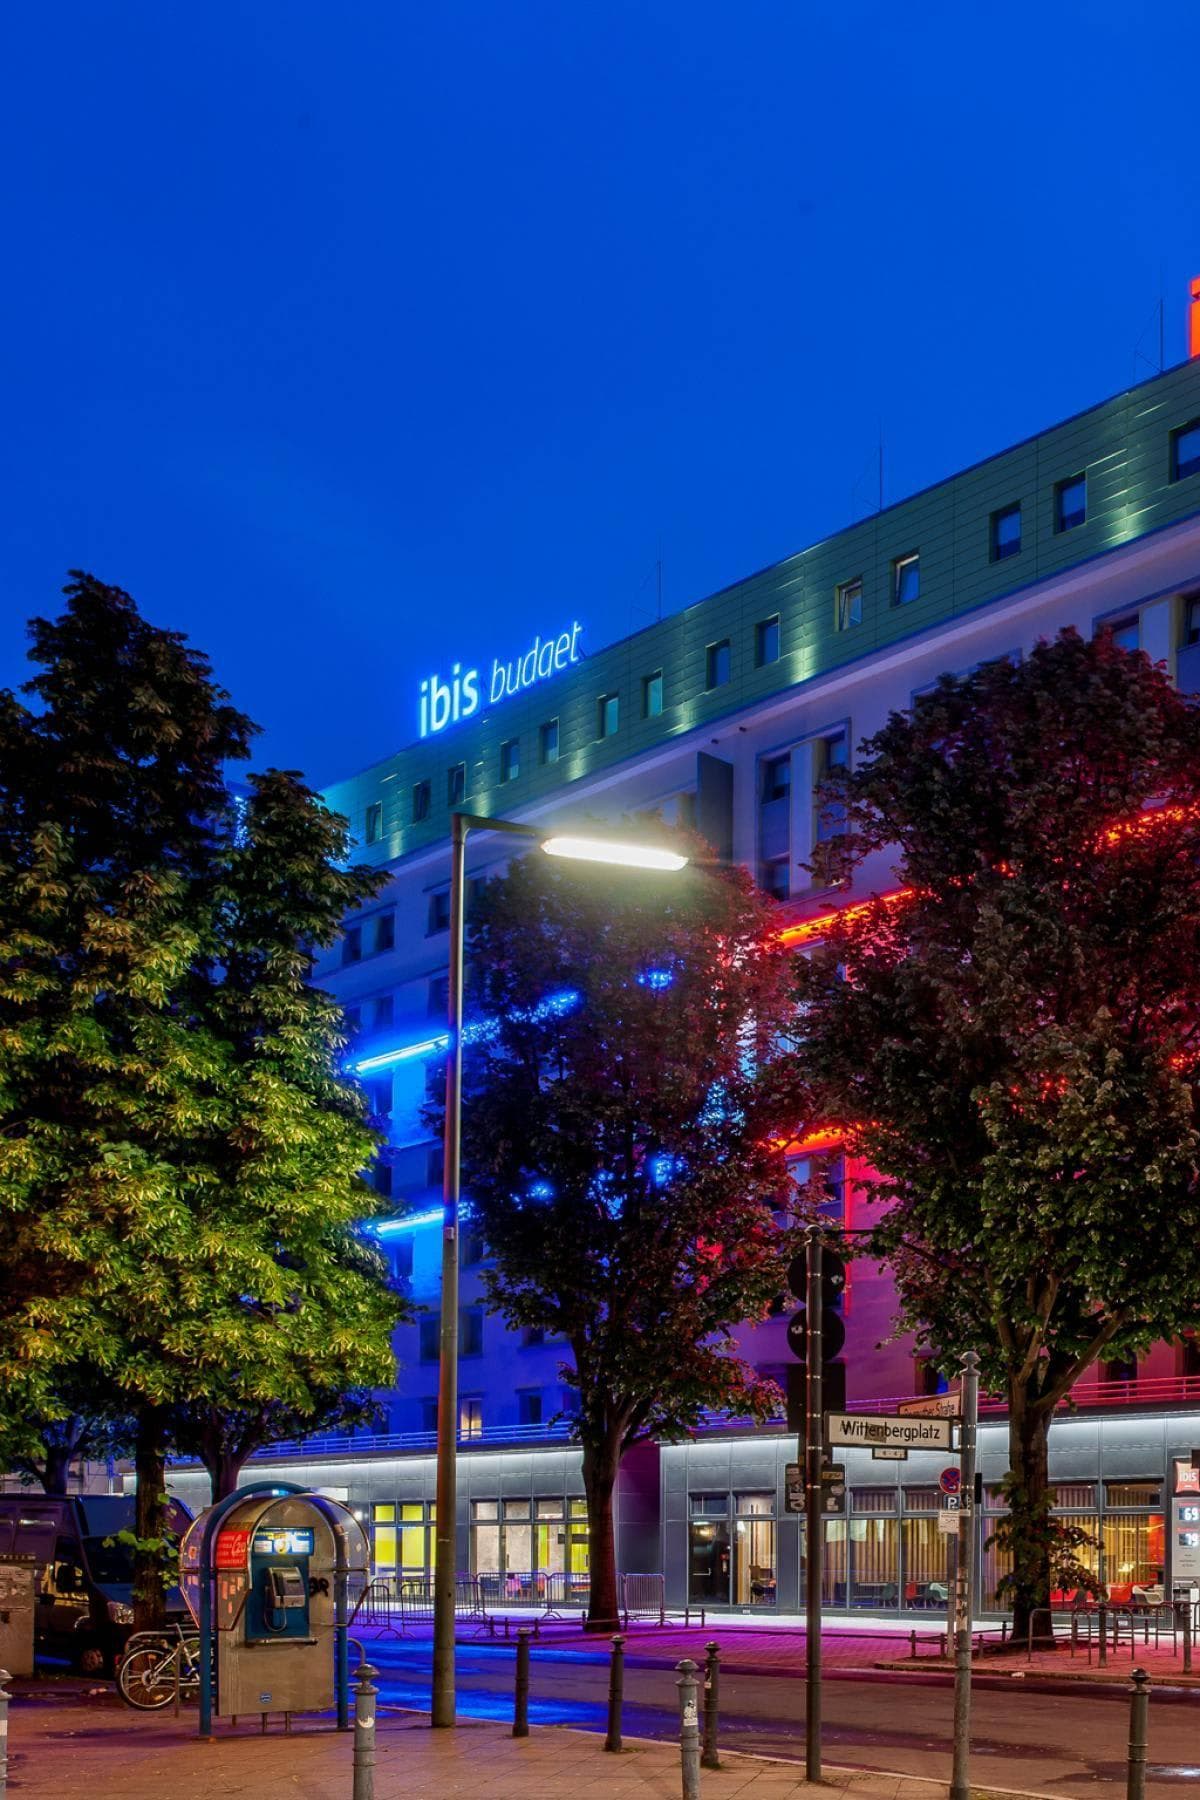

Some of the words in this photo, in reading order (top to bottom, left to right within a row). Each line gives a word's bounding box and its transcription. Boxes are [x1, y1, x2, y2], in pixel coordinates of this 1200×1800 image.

[420, 662, 479, 738] ibis
[840, 1420, 941, 1441] Wittenbergplatz
[1179, 1470, 1198, 1482] ibis
[1184, 1507, 1200, 1521] 69
